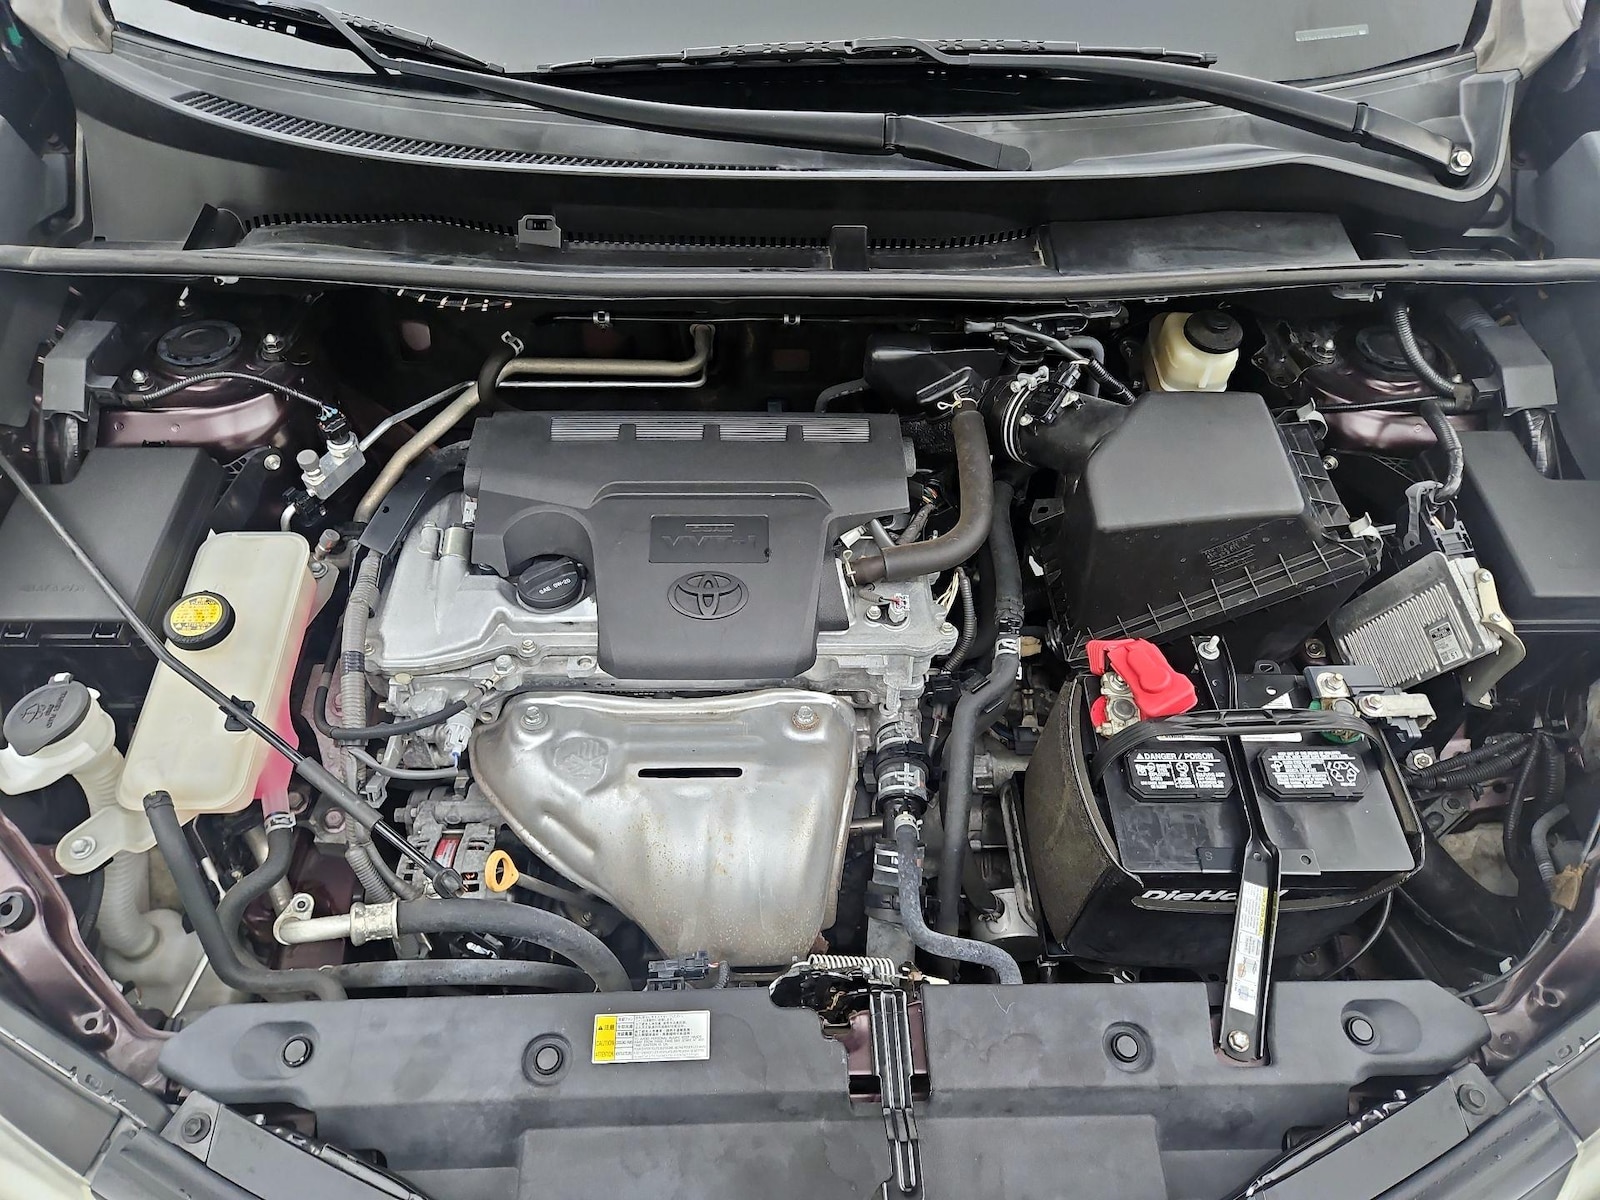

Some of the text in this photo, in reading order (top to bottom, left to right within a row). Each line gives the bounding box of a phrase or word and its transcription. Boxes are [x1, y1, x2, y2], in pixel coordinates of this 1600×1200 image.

[538, 578, 571, 595] SAE 0W-20
[1144, 752, 1177, 760] DANGER
[1184, 752, 1214, 760] POISON
